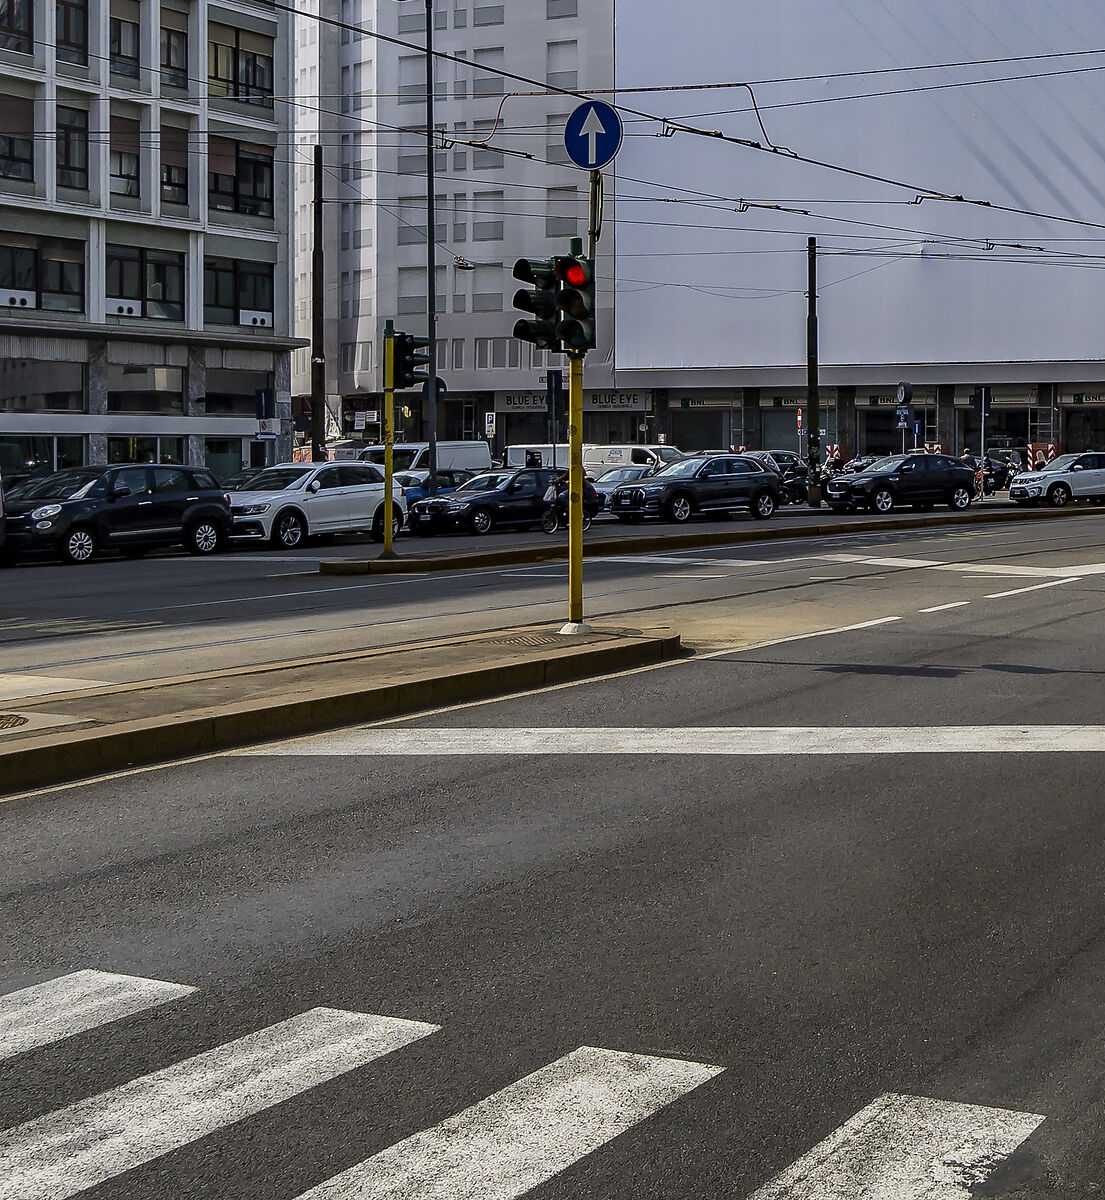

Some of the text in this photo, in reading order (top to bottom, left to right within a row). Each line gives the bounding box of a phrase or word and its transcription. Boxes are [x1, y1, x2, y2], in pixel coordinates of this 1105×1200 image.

[506, 395, 530, 406] BLUE
[592, 394, 638, 405] BLUE EYE
